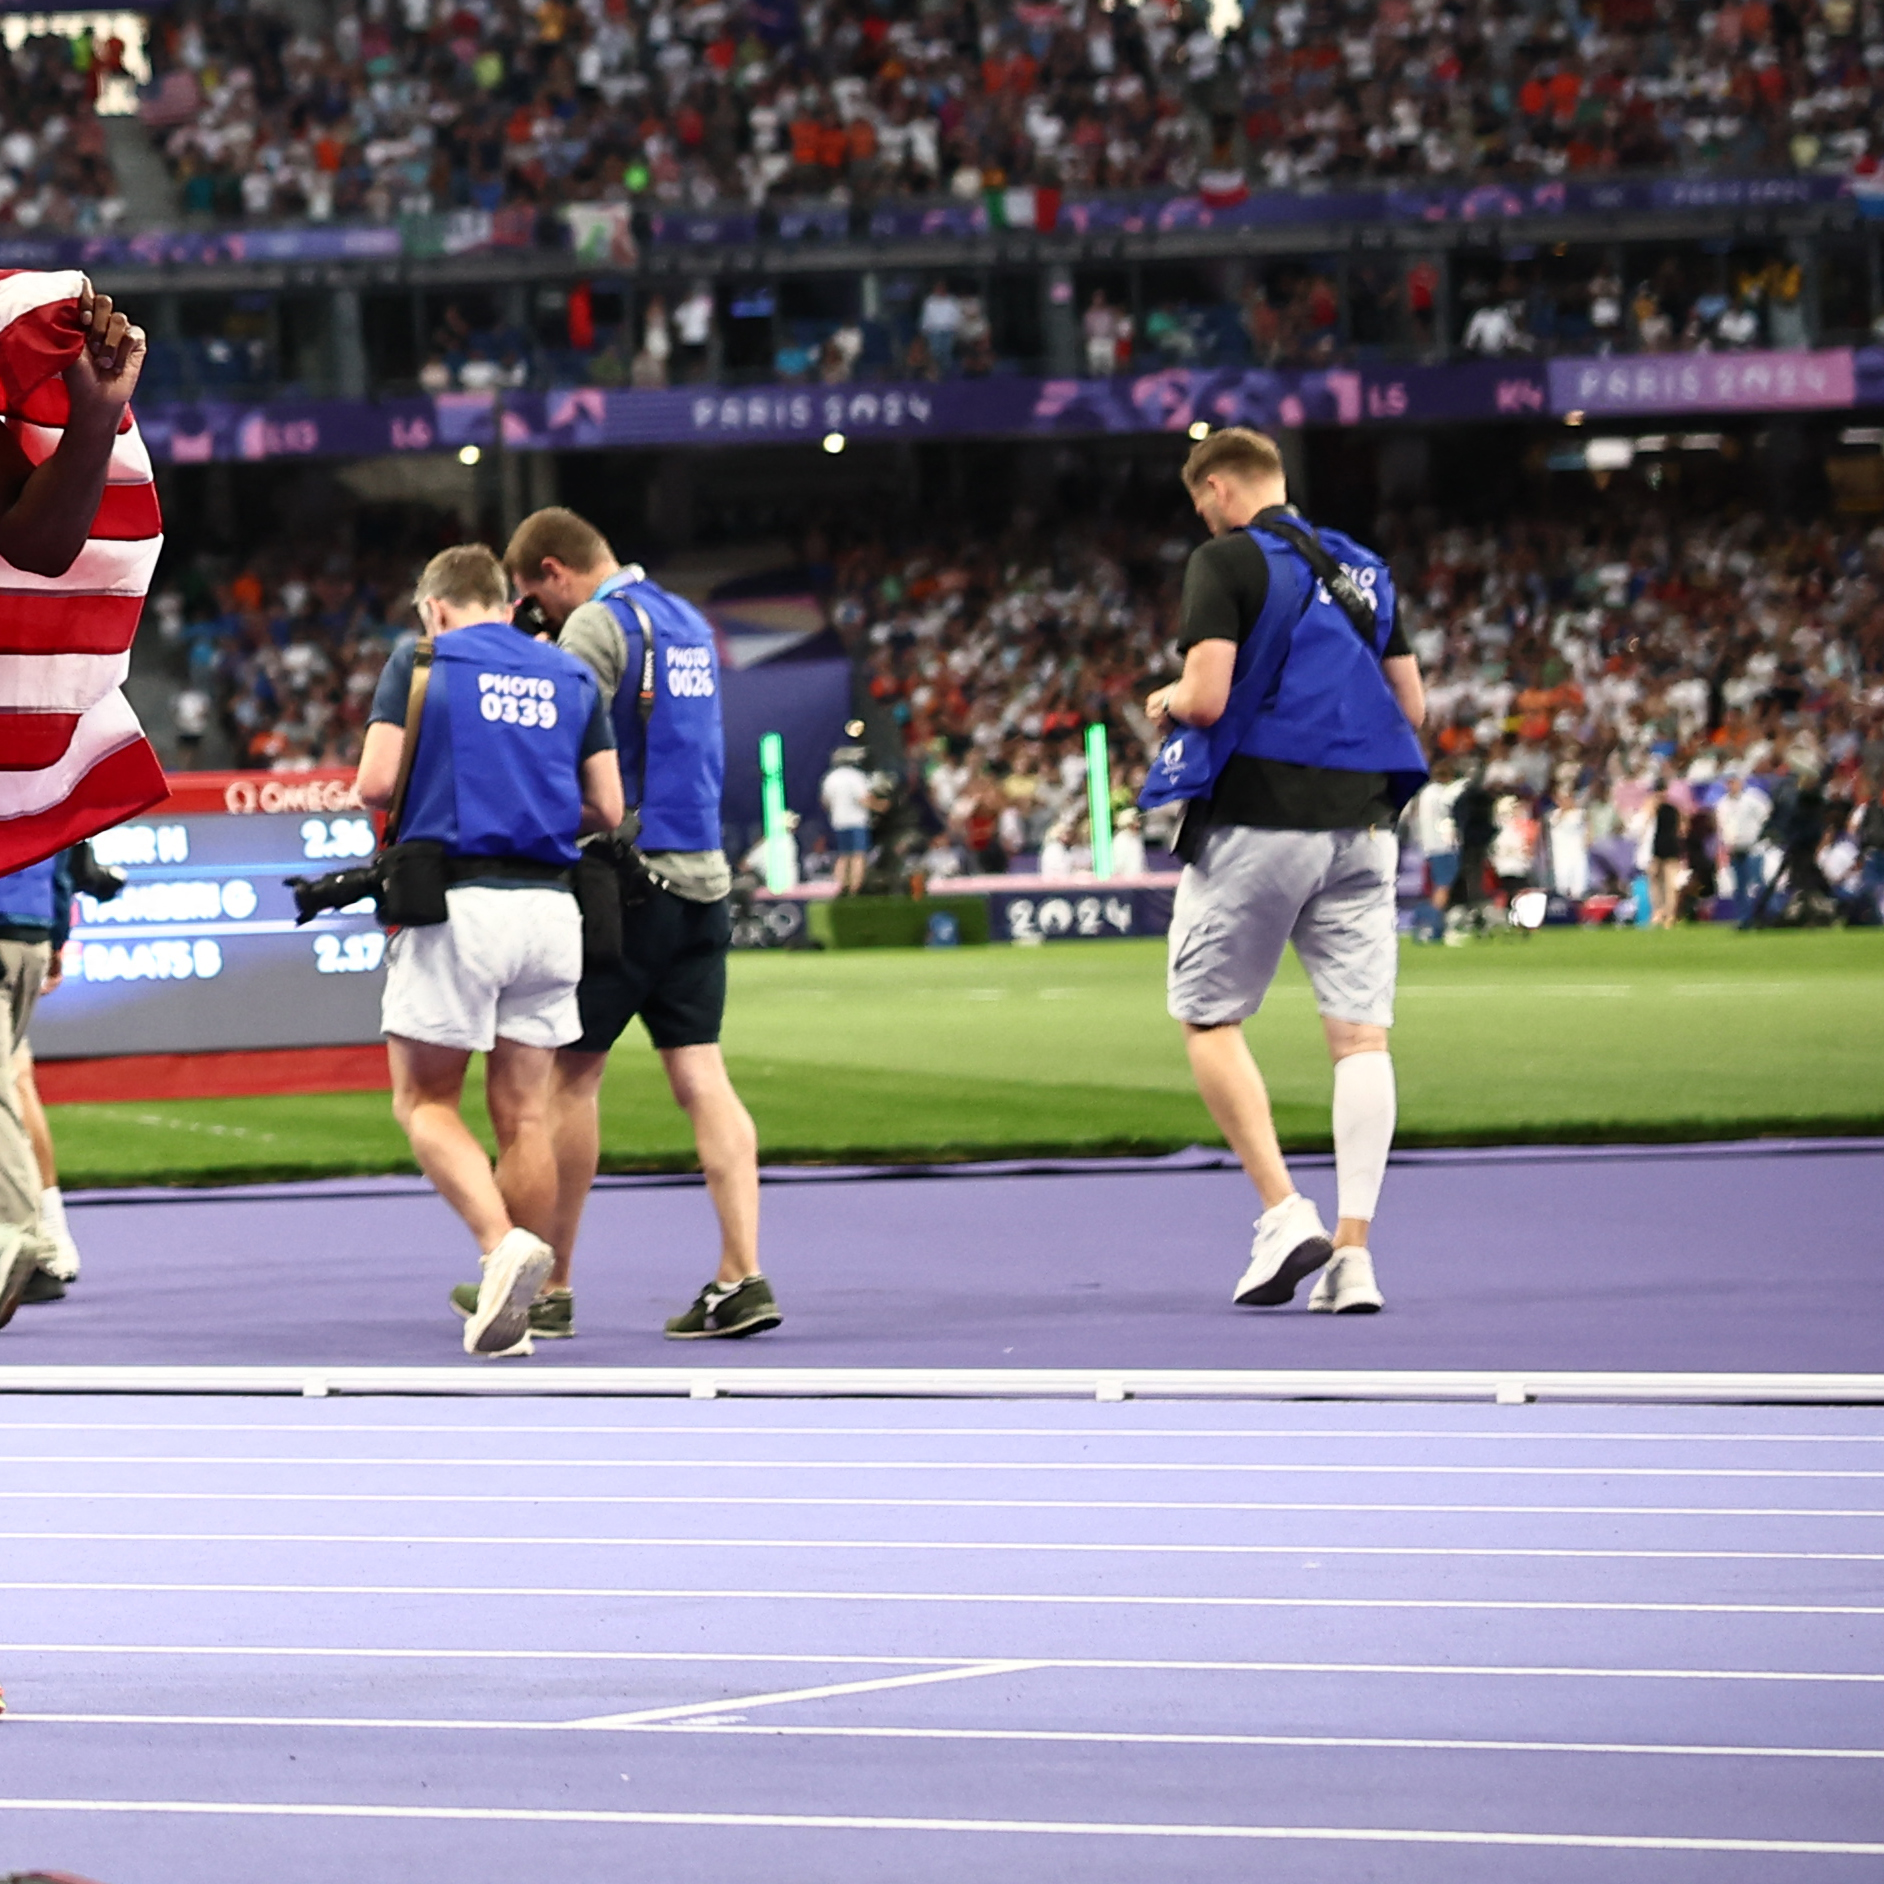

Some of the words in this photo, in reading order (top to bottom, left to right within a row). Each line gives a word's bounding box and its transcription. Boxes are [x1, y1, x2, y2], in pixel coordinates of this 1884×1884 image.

[1578, 362, 1700, 400] PARIS
[1715, 360, 1825, 399] 2024
[690, 395, 812, 431] PARIS
[824, 391, 930, 428] 2024
[666, 646, 710, 669] PHOTO
[478, 673, 555, 700] PHOTO
[480, 692, 558, 729] 0339
[260, 781, 366, 813] OMEGA
[1006, 897, 1131, 935] 2024
